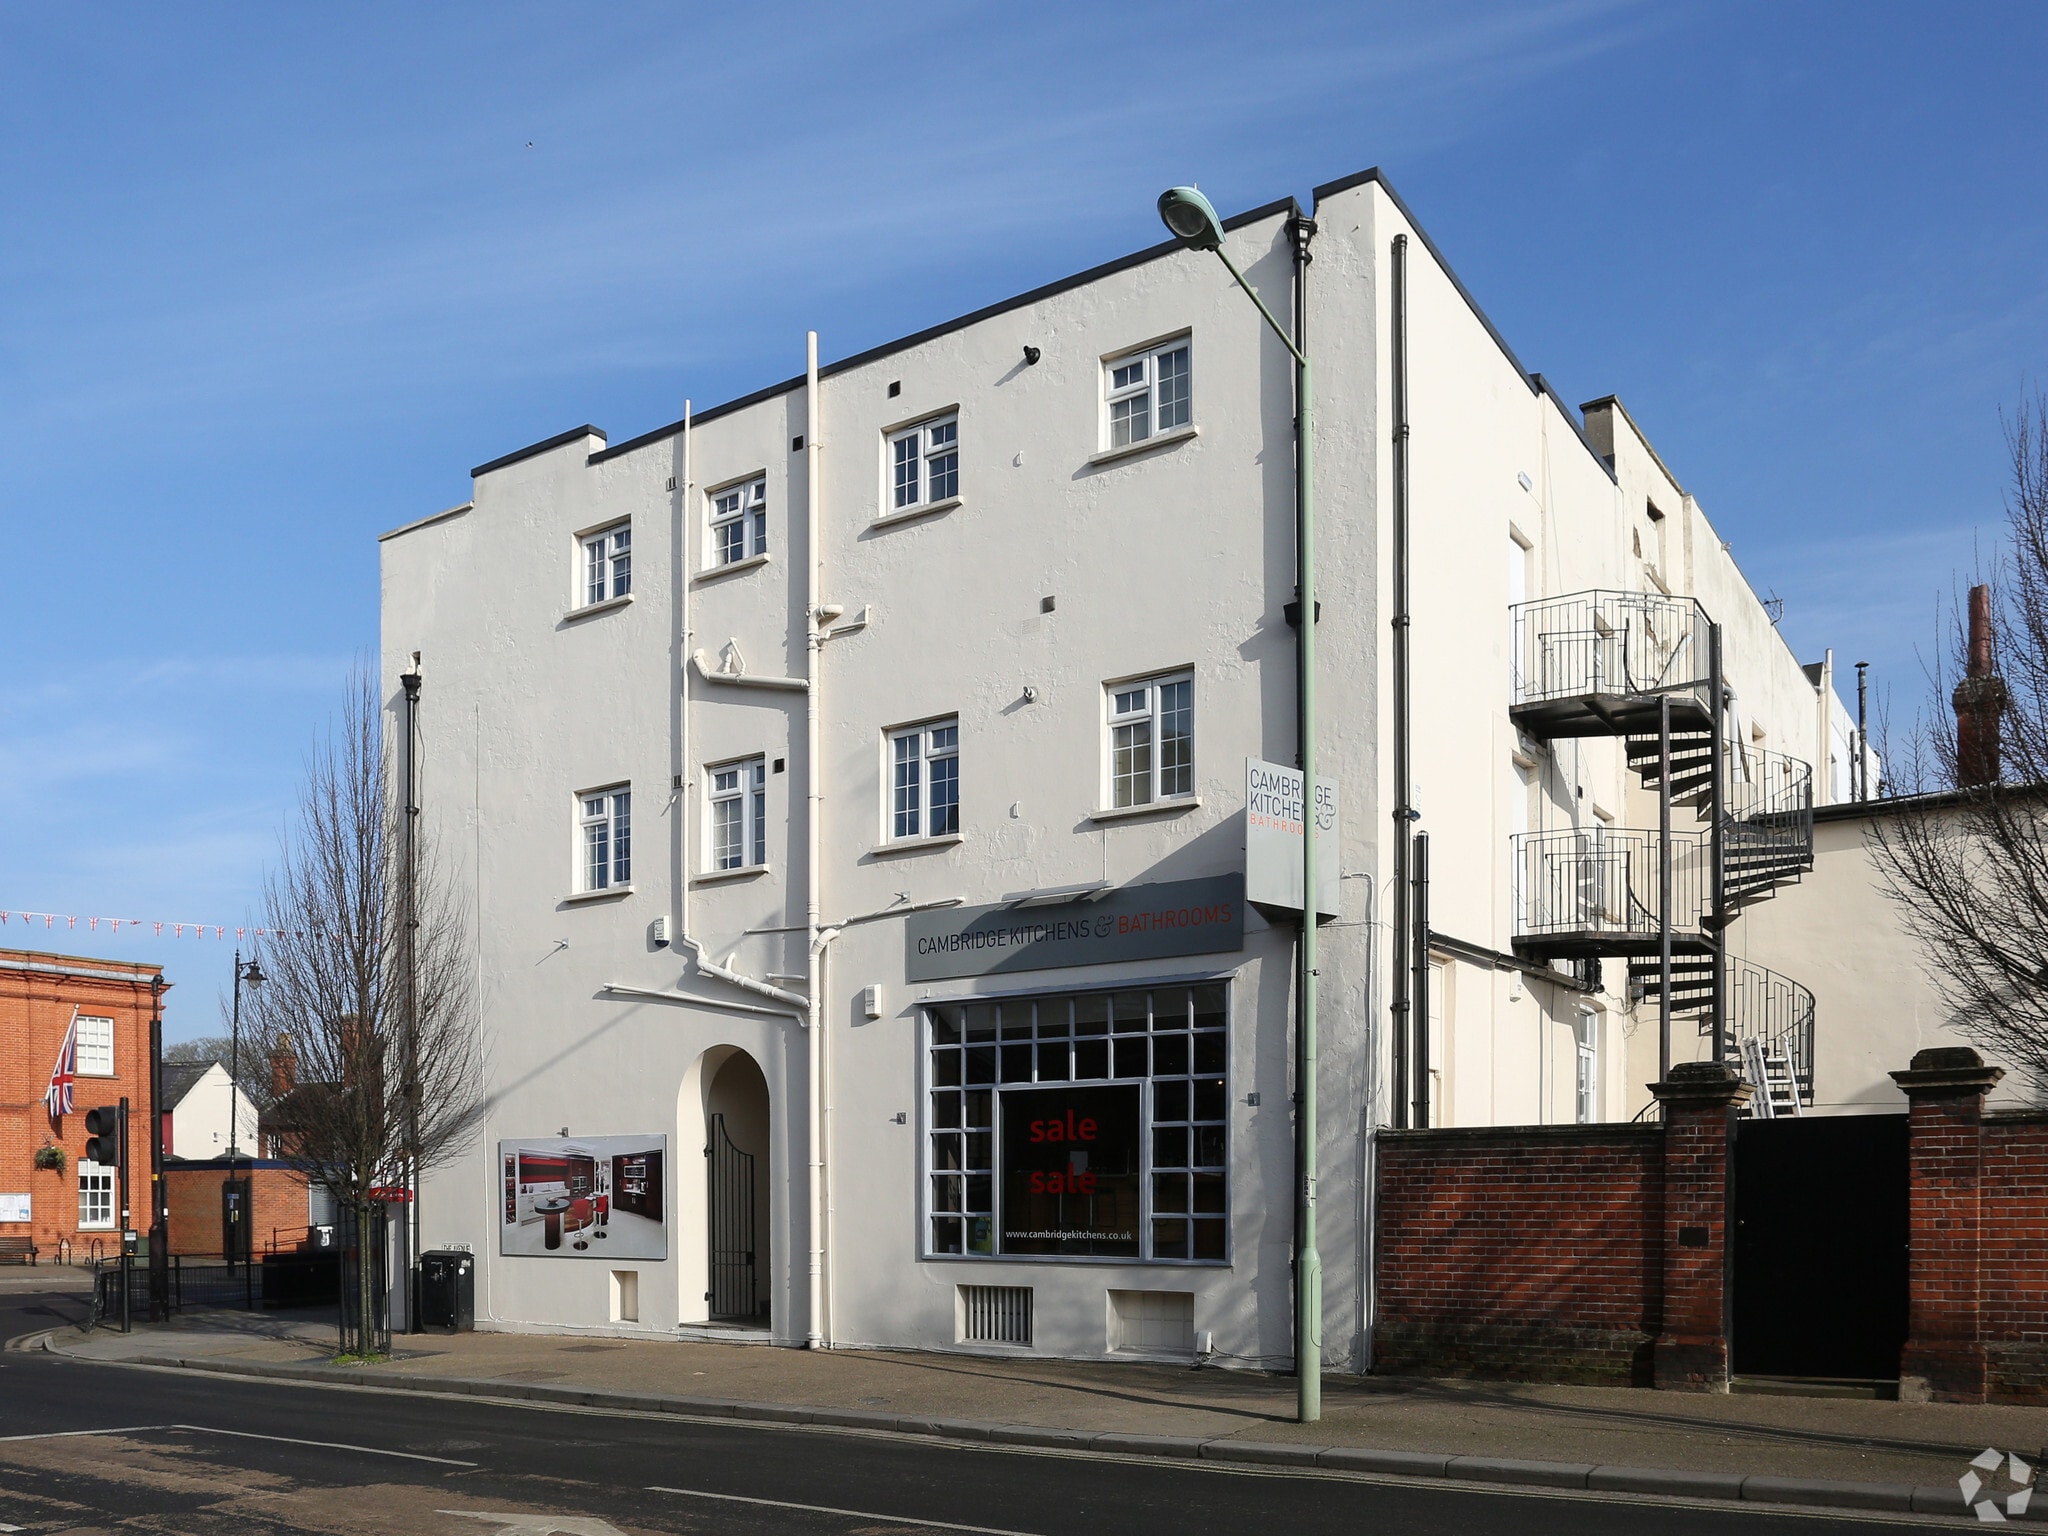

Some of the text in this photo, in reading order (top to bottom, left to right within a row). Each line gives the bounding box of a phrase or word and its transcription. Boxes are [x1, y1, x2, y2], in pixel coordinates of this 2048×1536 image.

[1250, 768, 1331, 804] CAMBRIGE
[1250, 813, 1319, 839] BATHROOS
[917, 904, 1232, 955] CAMBRIDGE KITCHENS & BATHROOMS
[1029, 1109, 1098, 1142] sale
[1029, 1162, 1097, 1194] sale
[1005, 1230, 1132, 1241] www.cambridgekitchens.co.uk
